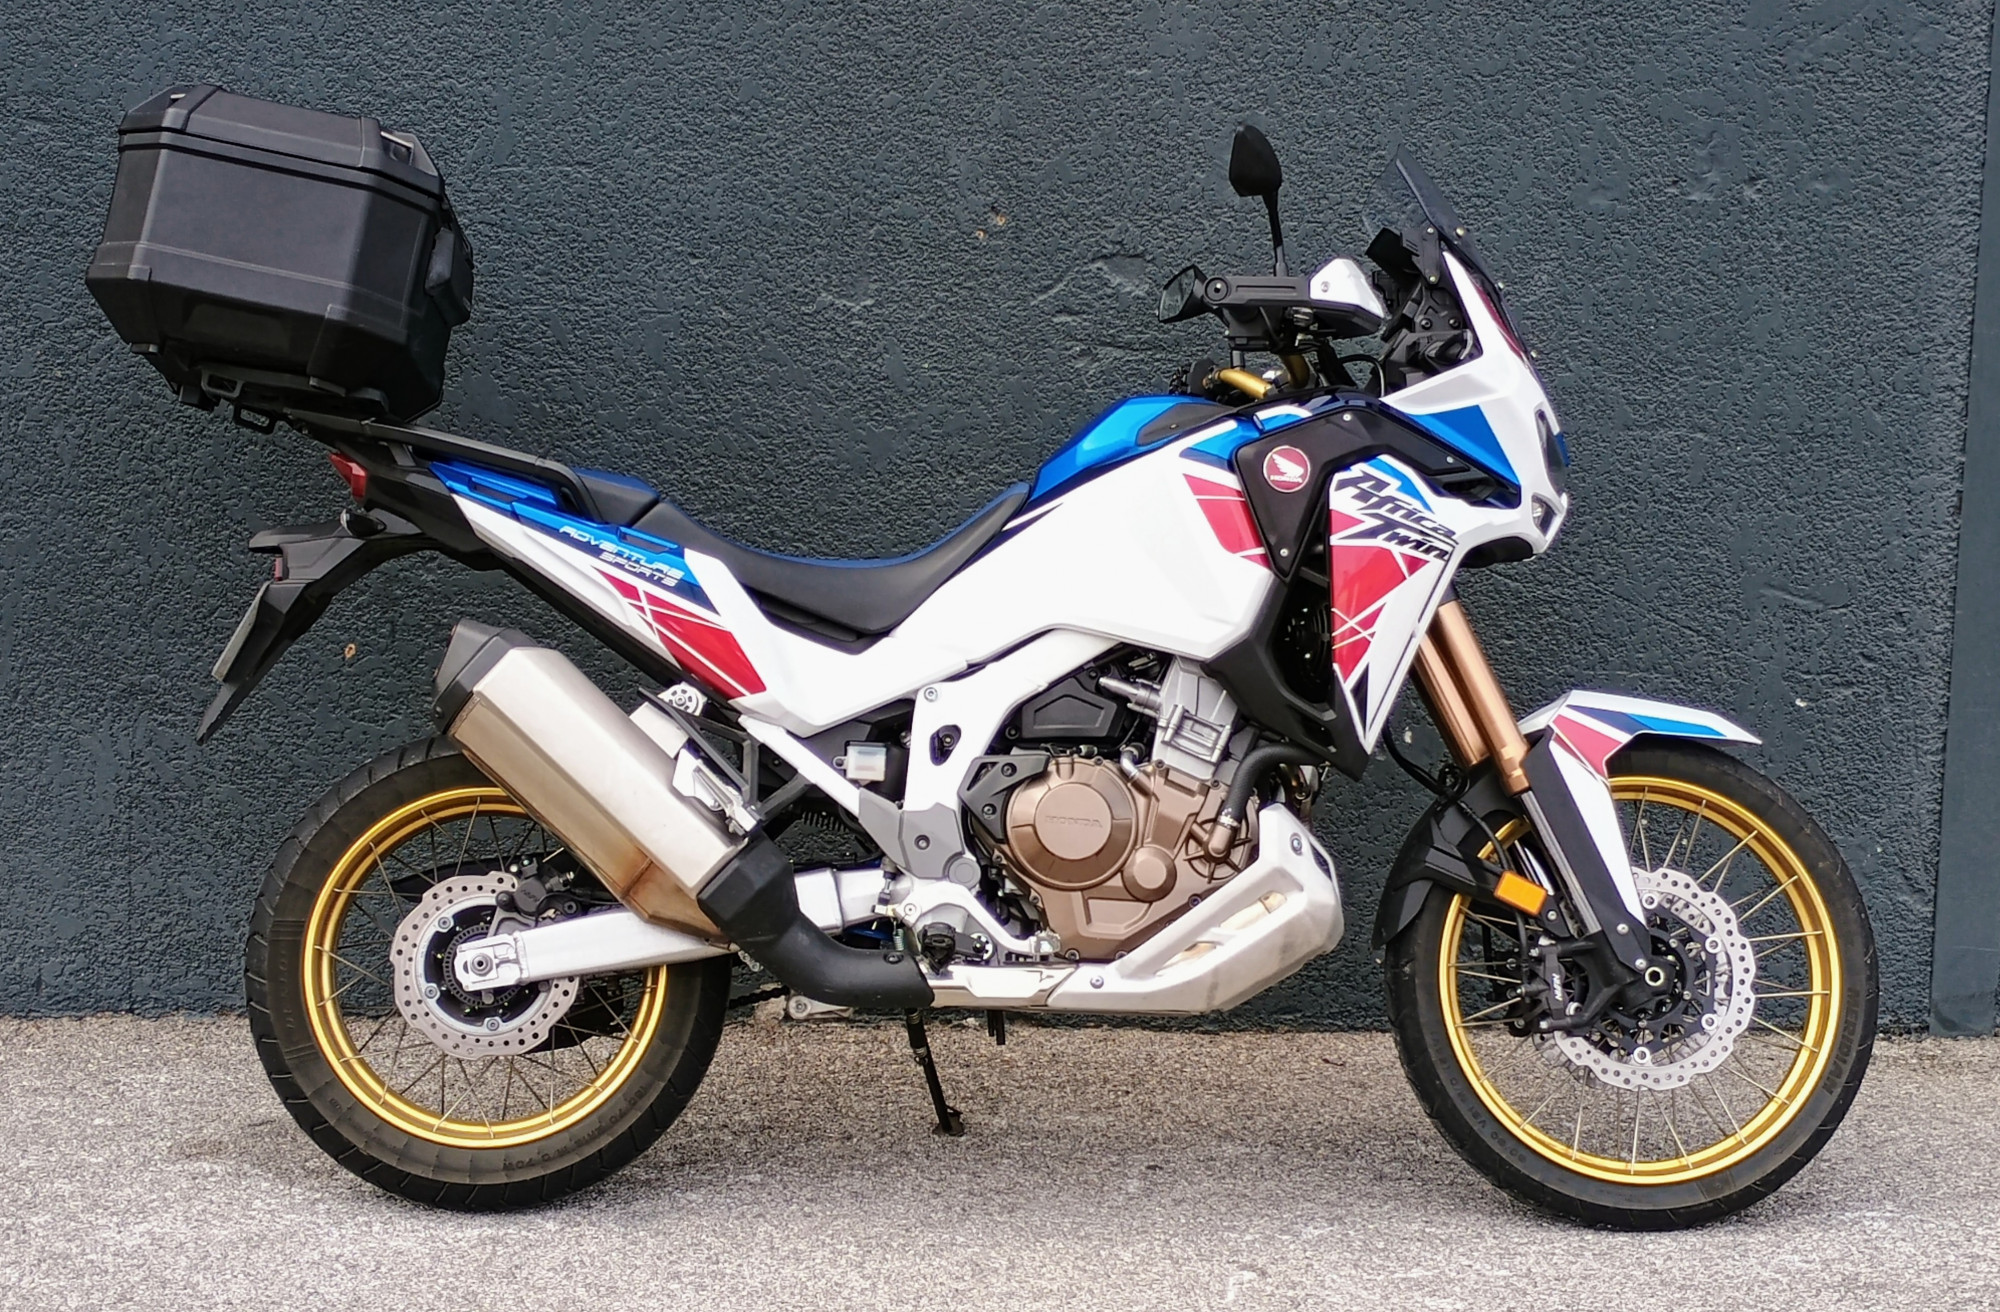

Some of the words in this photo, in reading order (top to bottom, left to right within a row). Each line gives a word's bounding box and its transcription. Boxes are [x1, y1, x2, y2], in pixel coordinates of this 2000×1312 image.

[1334, 469, 1458, 544] Africa
[559, 525, 685, 580] ADVENTURE
[1337, 512, 1456, 561] Twin
[599, 551, 679, 587] SPORTS
[1782, 987, 1860, 1095] MERIDIAN
